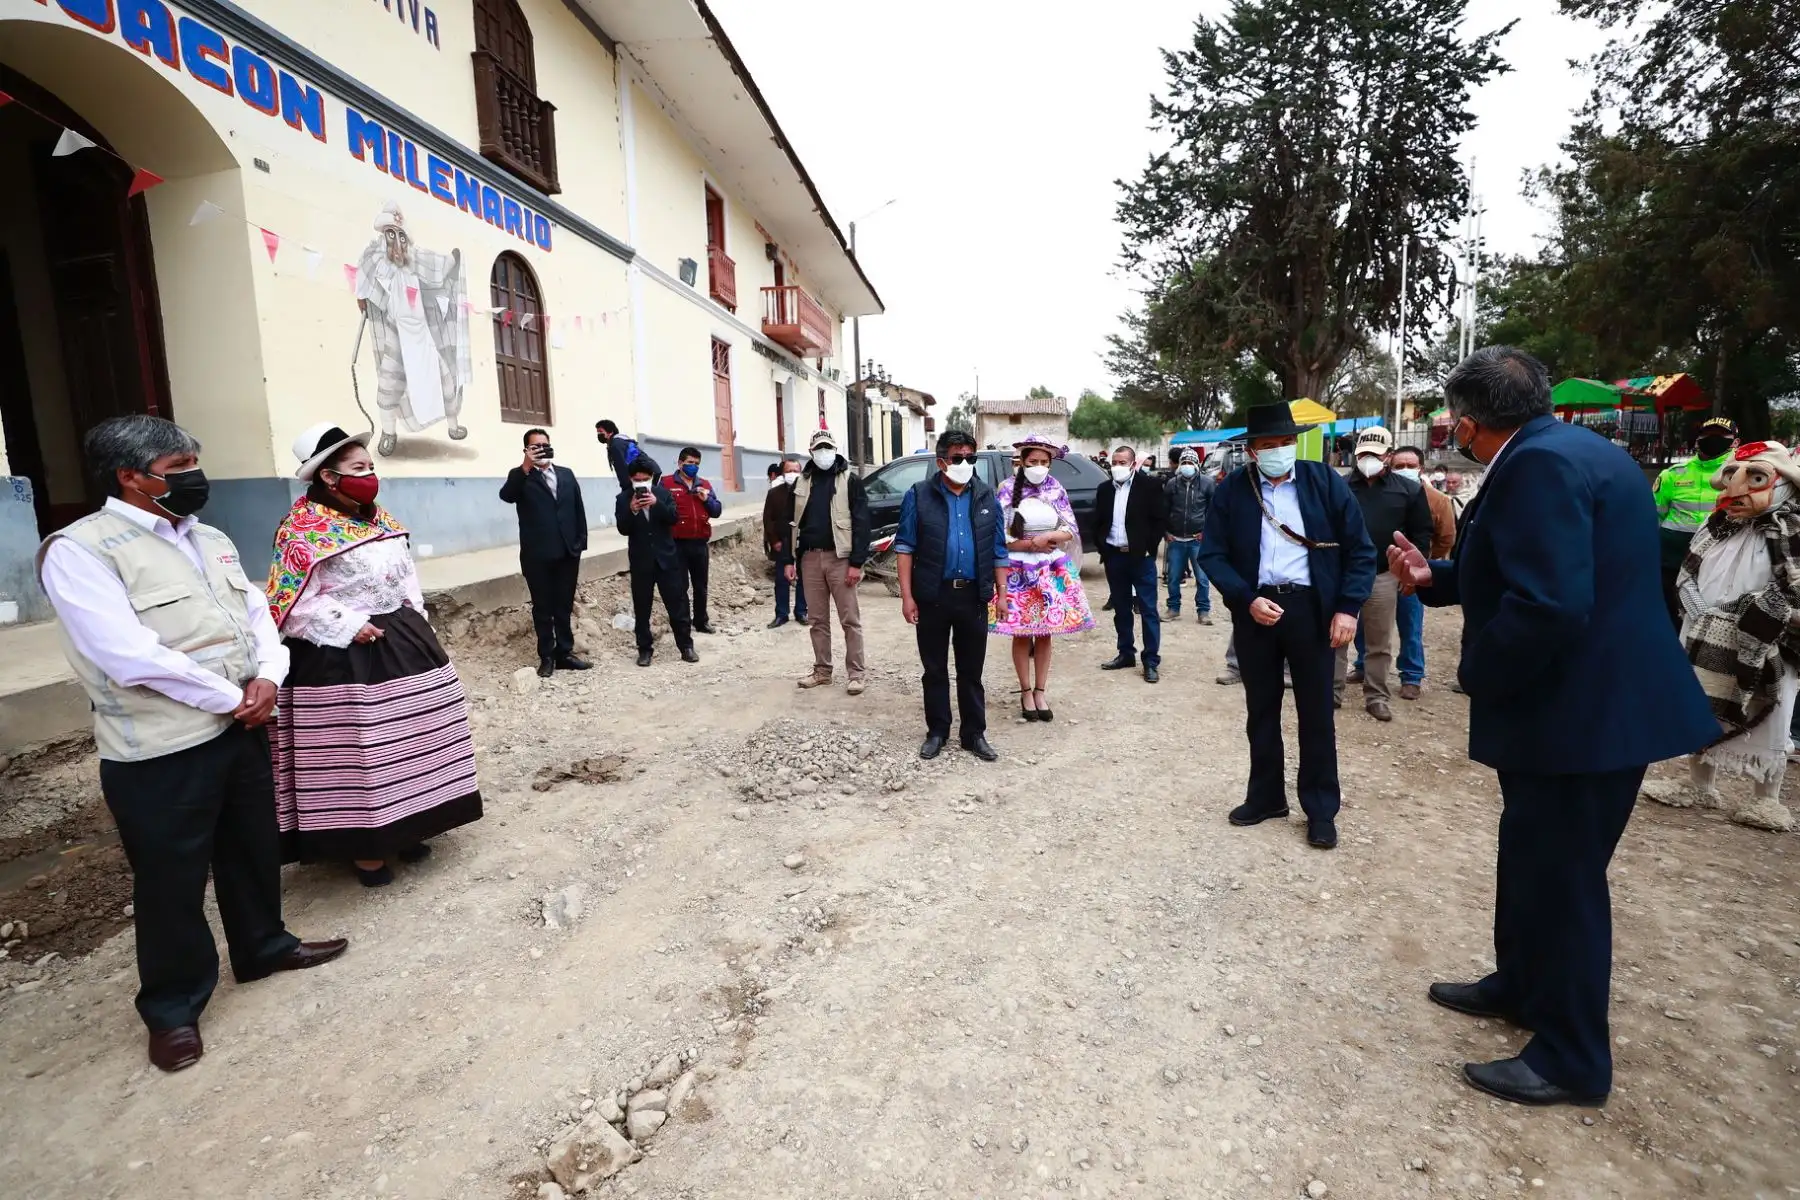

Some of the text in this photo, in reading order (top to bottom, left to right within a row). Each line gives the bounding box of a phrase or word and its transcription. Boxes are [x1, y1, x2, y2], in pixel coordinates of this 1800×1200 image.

[382, 0, 440, 52] IVA
[33, 0, 327, 144] ACON
[1702, 416, 1732, 428] POLICIA
[1359, 432, 1386, 445] POLICIA
